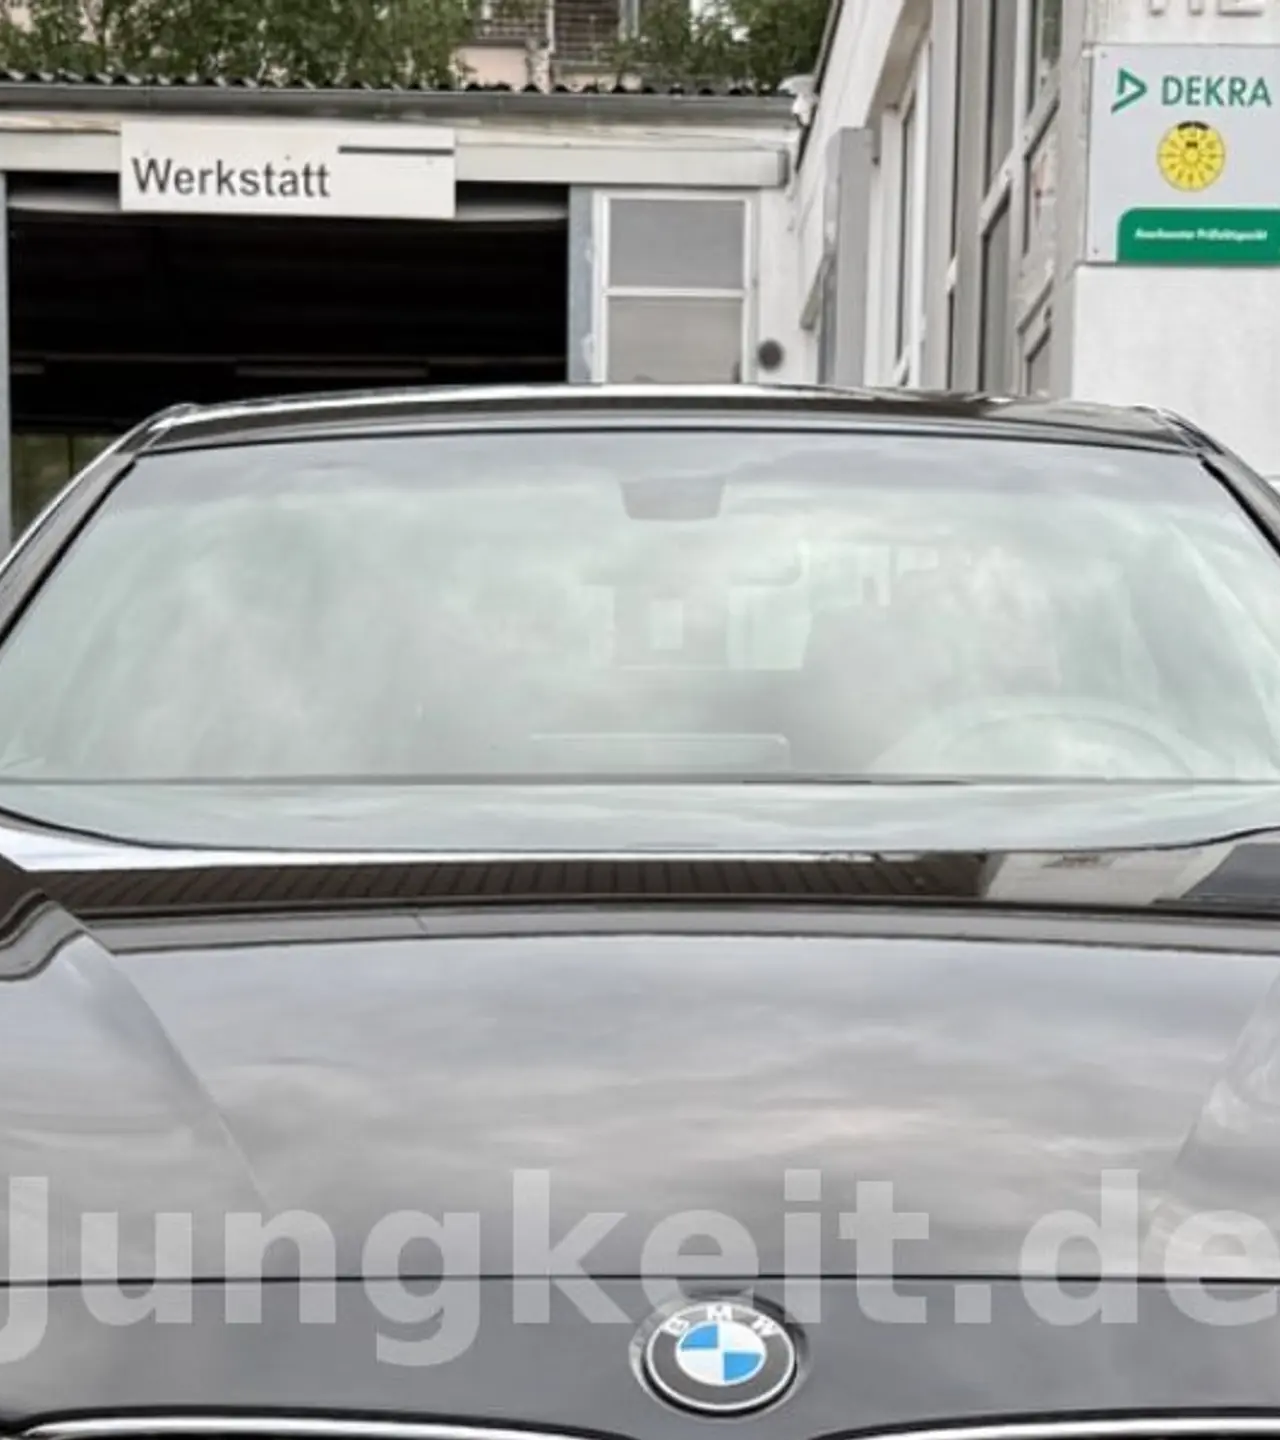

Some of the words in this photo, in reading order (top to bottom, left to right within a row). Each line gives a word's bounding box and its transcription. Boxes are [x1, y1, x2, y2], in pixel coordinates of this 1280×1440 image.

[1161, 75, 1272, 107] DEKRA
[131, 157, 331, 198] Werkstatt
[660, 1303, 781, 1338] BMW
